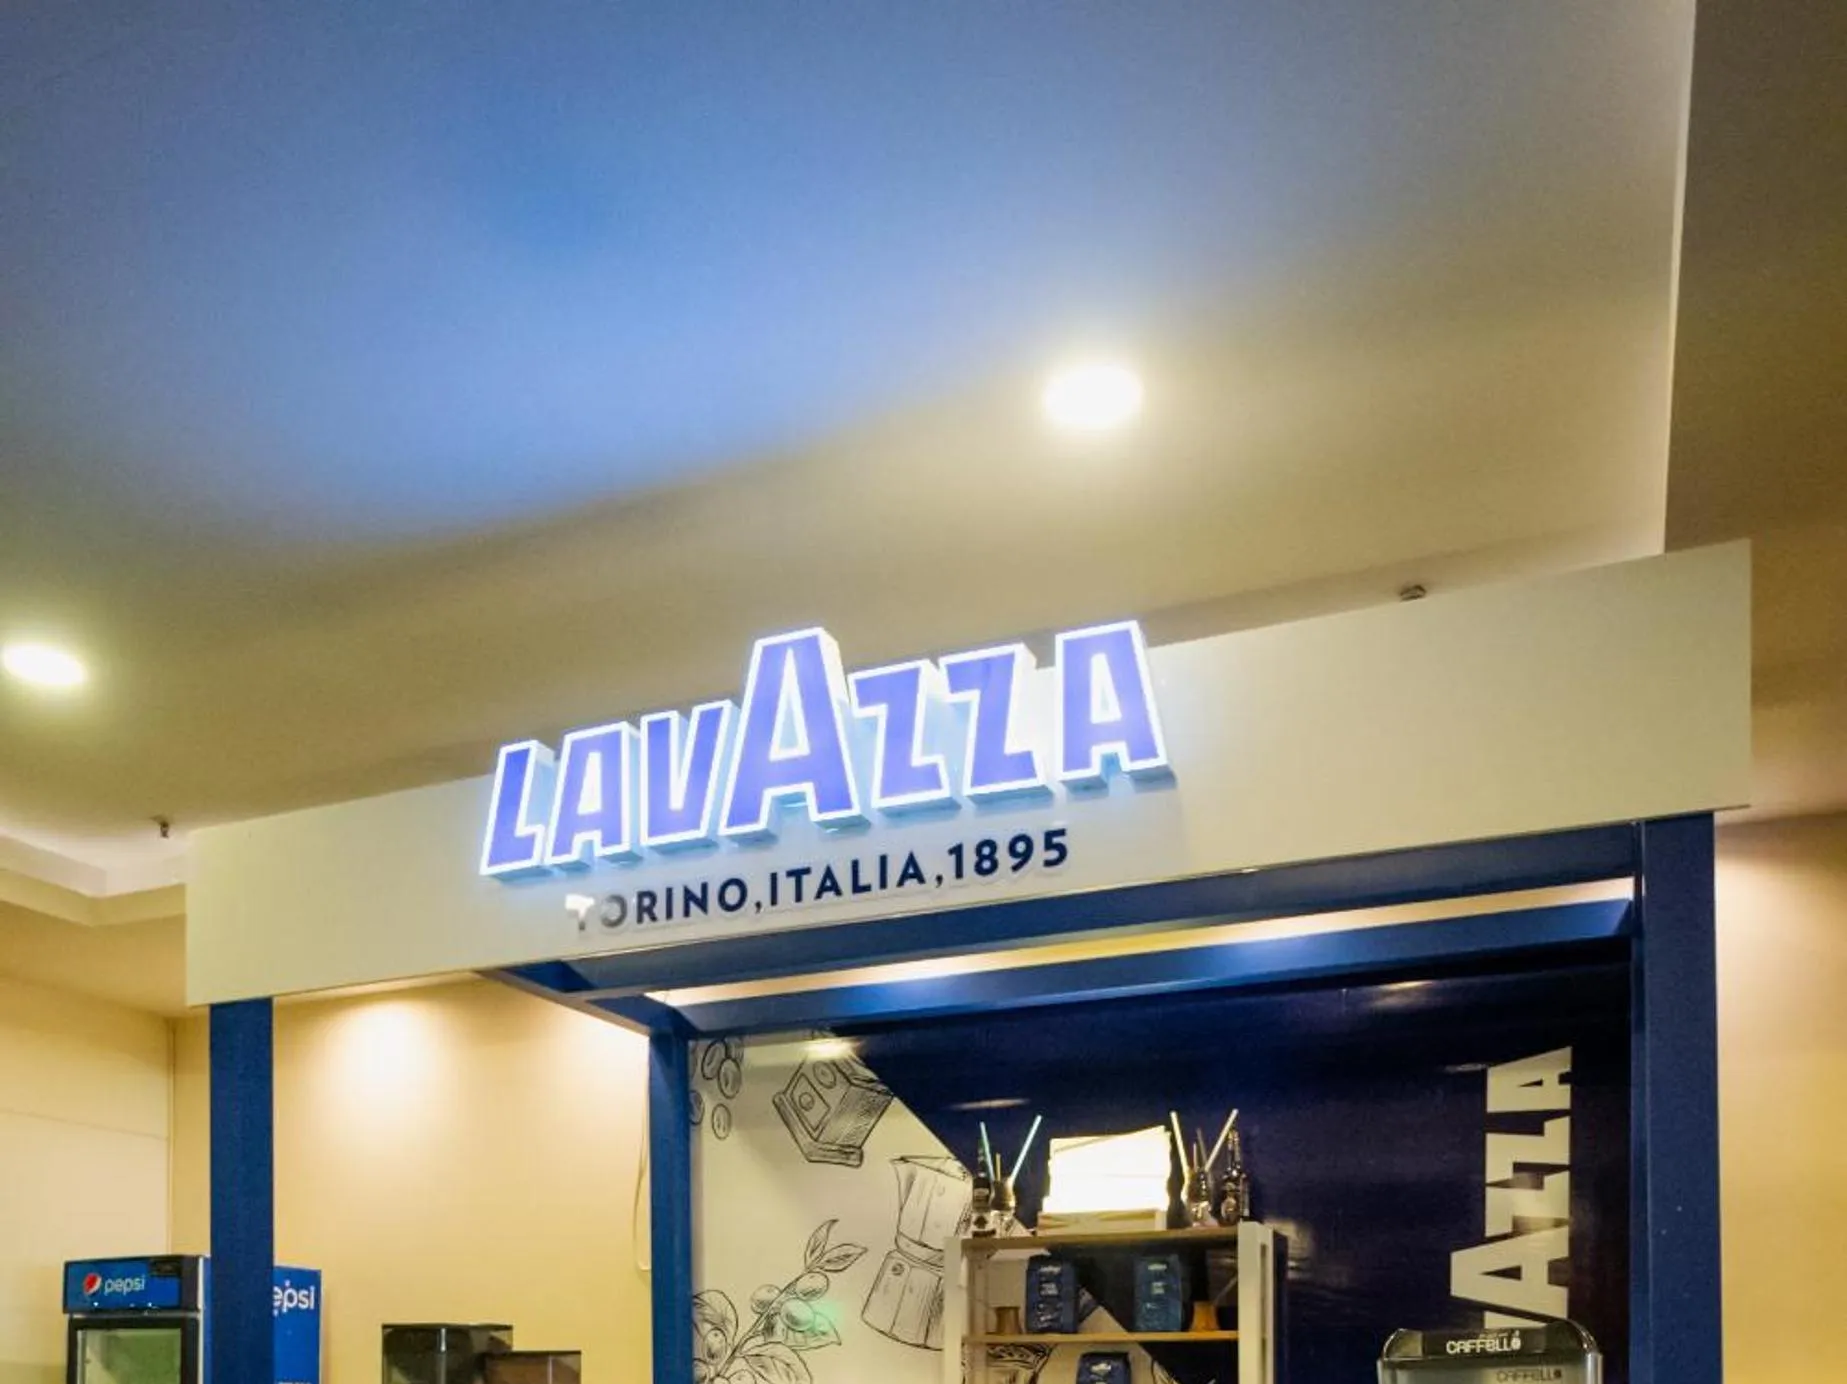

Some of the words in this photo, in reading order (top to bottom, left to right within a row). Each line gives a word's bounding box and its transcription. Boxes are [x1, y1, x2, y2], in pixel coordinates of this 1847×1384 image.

[480, 621, 1177, 881] LAVAZZA
[103, 1274, 146, 1296] pepsi
[273, 1284, 316, 1315] epsi
